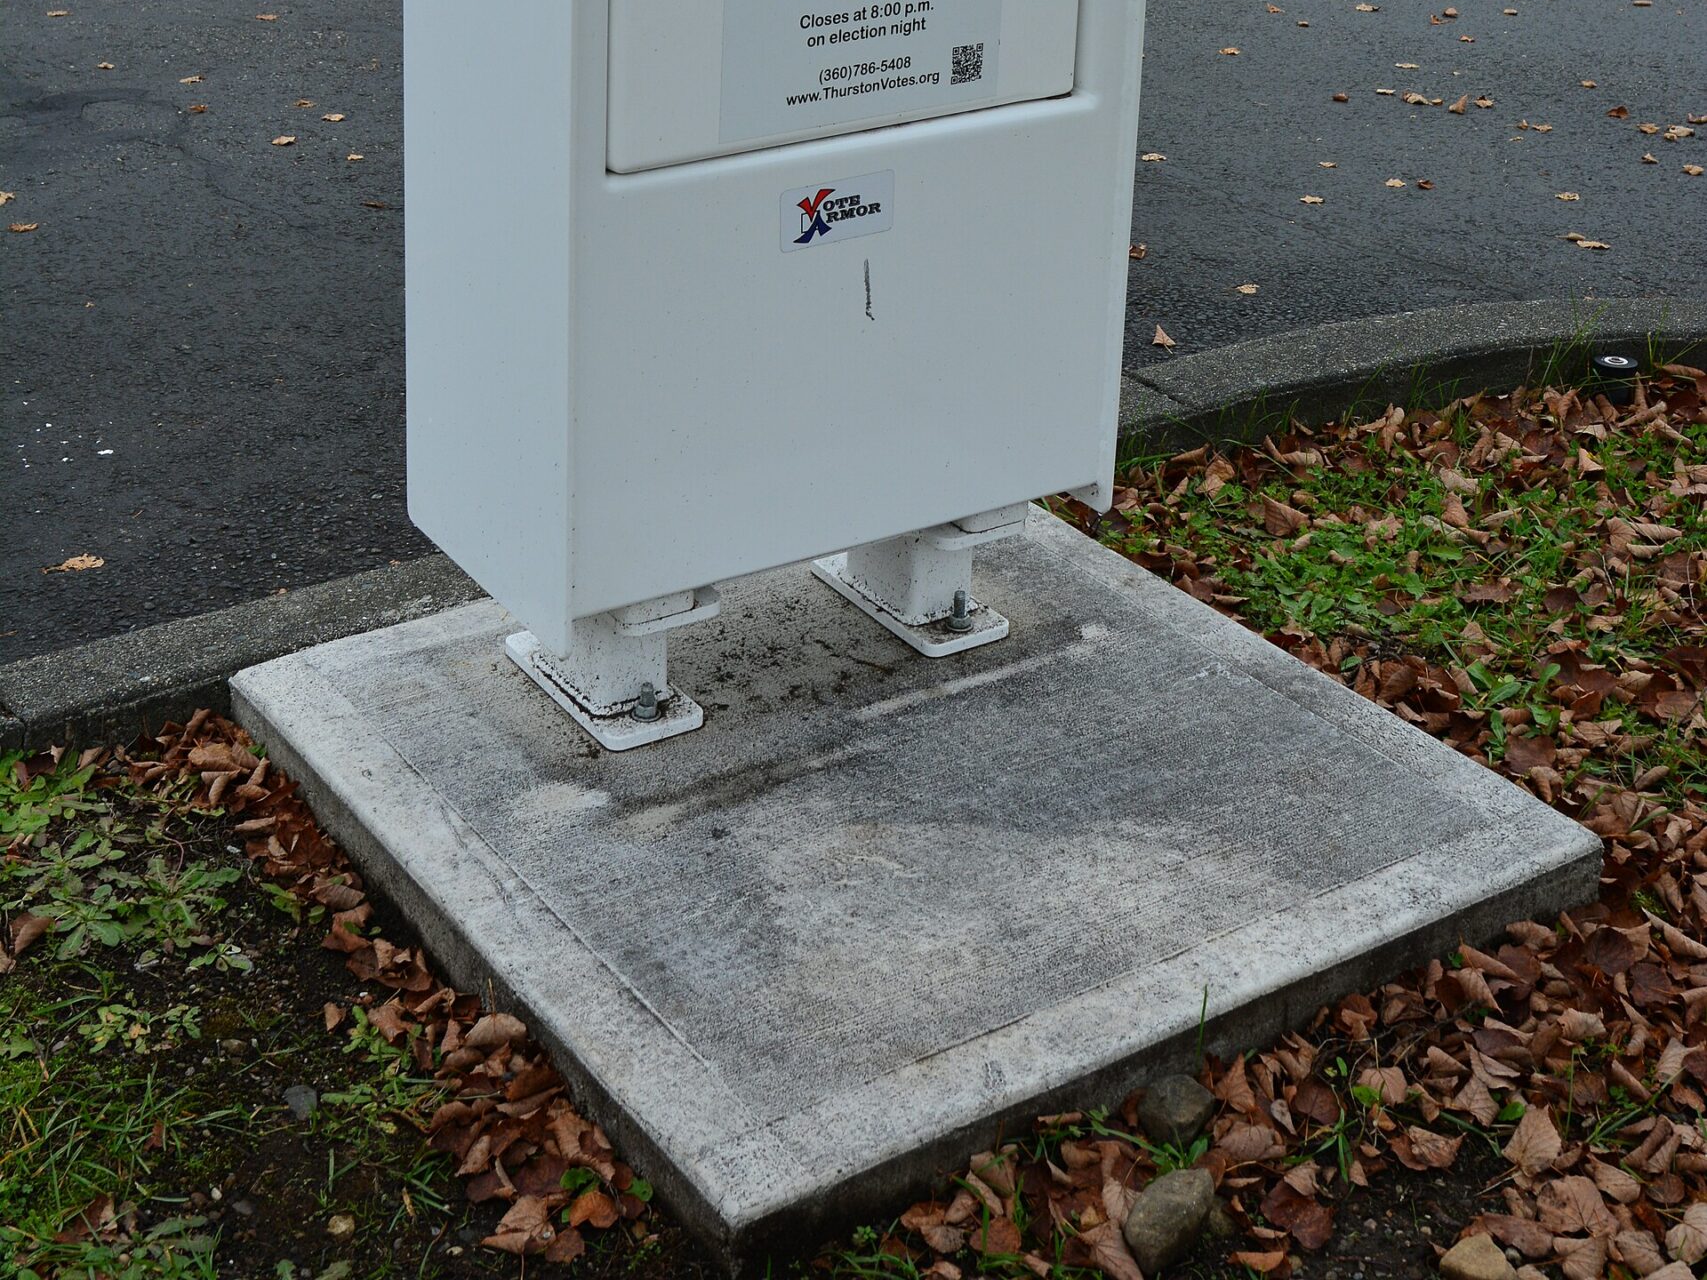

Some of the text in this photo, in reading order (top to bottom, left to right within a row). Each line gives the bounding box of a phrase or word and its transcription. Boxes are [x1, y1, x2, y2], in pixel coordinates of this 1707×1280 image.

[800, 0, 934, 29] Closes at 8:00 p.m.
[807, 17, 926, 48] on election night
[819, 56, 911, 85] (360)786-5408
[786, 71, 940, 106] www.ThurstonVotes.org
